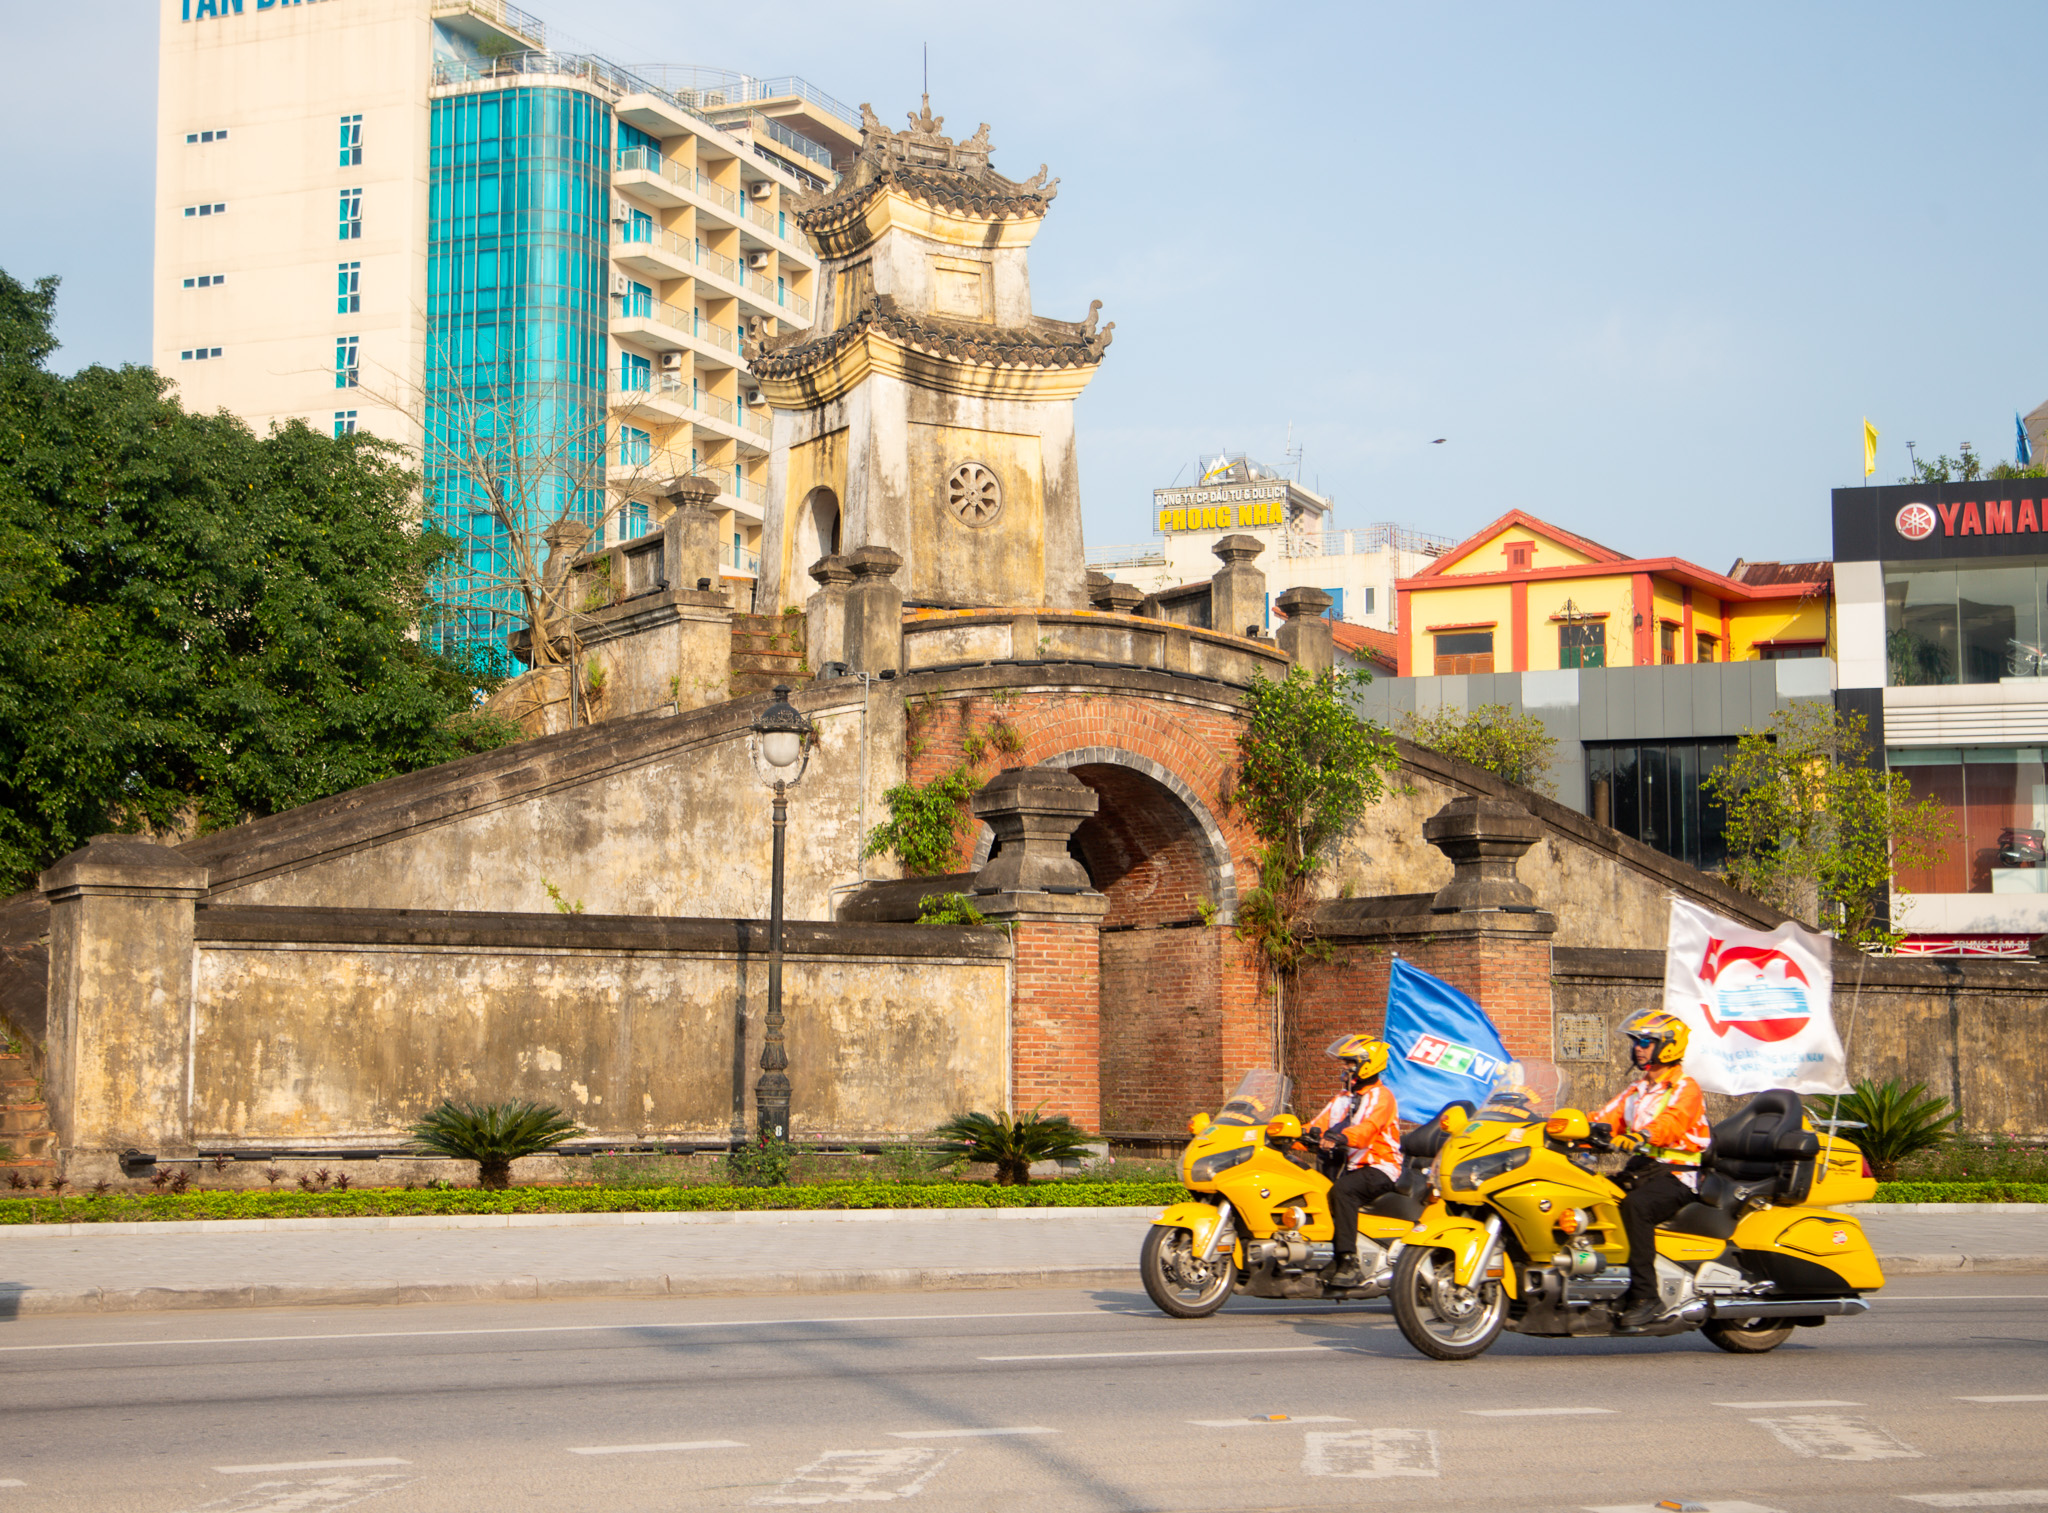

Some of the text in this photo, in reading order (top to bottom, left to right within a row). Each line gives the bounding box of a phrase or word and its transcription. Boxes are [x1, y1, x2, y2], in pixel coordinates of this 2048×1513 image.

[1184, 493, 1195, 504] TY
[1197, 491, 1208, 503] CP
[1244, 489, 1250, 500] &
[1252, 487, 1264, 499] DU
[1159, 502, 1283, 531] PHONG NHA
[1937, 498, 2048, 537] YAMA
[1413, 1039, 1493, 1077] HTV
[775, 1125, 782, 1137] 8
